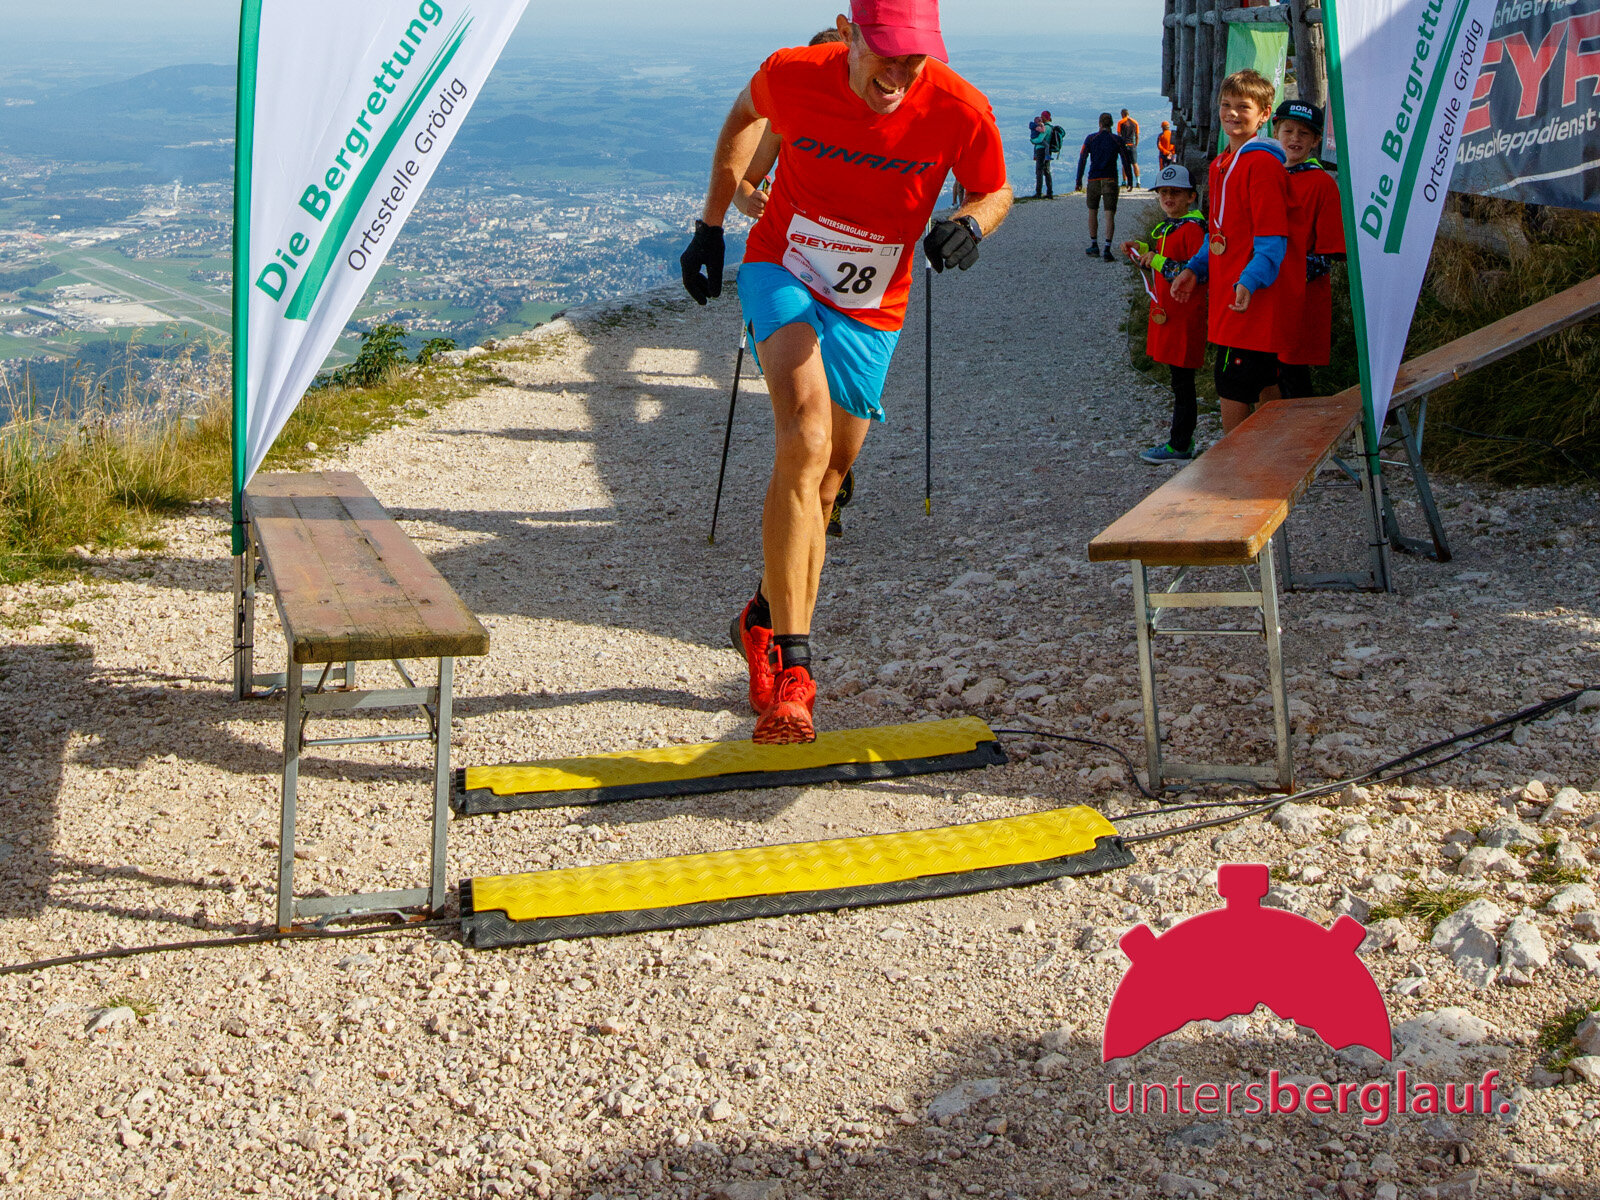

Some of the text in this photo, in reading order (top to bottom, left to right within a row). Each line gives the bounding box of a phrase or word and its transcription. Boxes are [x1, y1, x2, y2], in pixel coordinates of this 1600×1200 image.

[1289, 104, 1313, 116] BORA
[1424, 18, 1484, 203] Ortsstelle Grödig
[791, 136, 938, 176] DYNAFIT
[1456, 107, 1600, 165] Abschleppdienst
[347, 77, 468, 272] Ortsstelle Grödig
[818, 215, 869, 238] UNTERSBERGLAUF
[869, 232, 885, 242] 2022
[1360, 173, 1394, 240] Die
[255, 231, 310, 302] Die
[790, 233, 873, 253] BEYRINGER
[832, 261, 877, 295] 28
